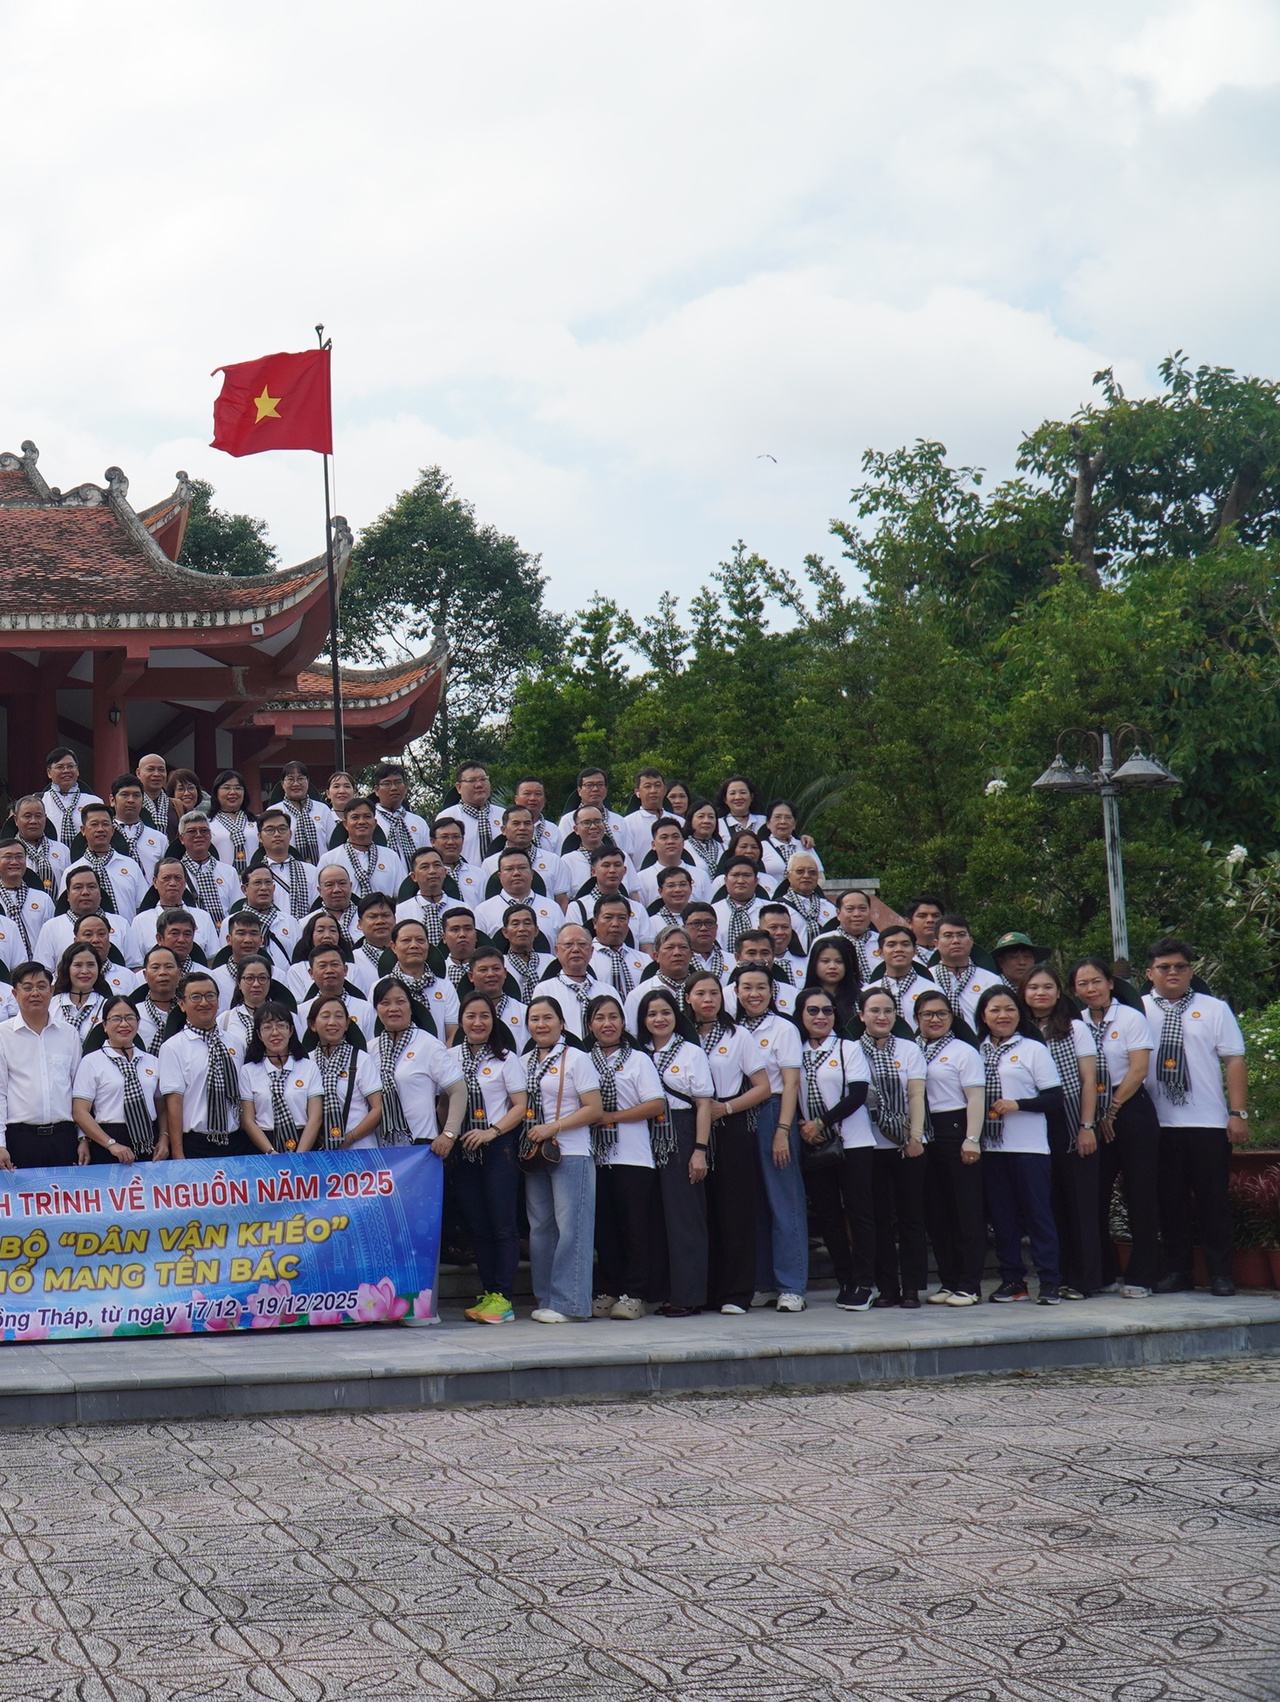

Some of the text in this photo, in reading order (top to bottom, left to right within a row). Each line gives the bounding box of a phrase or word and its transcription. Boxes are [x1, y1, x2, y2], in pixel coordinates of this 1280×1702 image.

[19, 1184, 102, 1216] TRÌNH
[108, 1175, 145, 1211] VỀ
[153, 1170, 249, 1209] NGUỒN
[257, 1170, 318, 1203] NĂM
[327, 1171, 394, 1198] 2025
[58, 1225, 149, 1257] “DÂN
[158, 1220, 228, 1257] VẬN
[237, 1213, 349, 1247] KHÉO”
[43, 1263, 145, 1293] MANG
[155, 1255, 219, 1287] TÊN
[229, 1250, 301, 1283] BÁC
[38, 1307, 94, 1329] Tháp,
[100, 1305, 124, 1323] từ
[127, 1304, 178, 1325] ngày
[185, 1299, 237, 1320] 17/12
[257, 1291, 359, 1315] 19/12/2025
